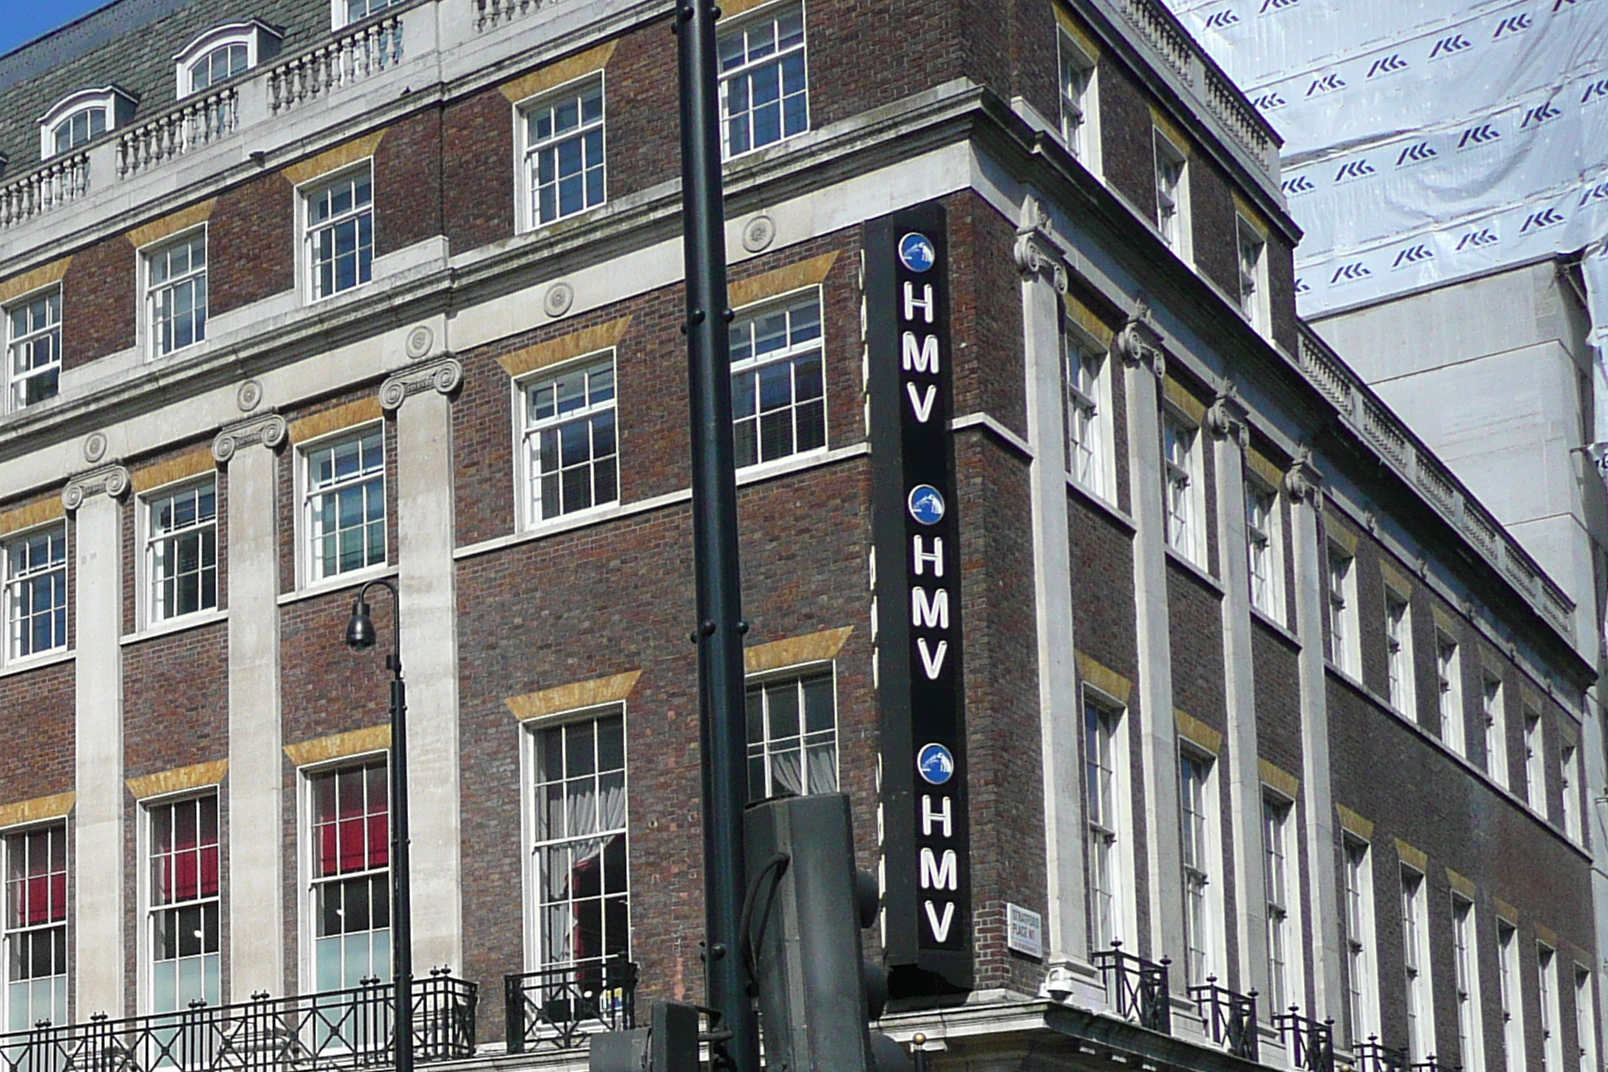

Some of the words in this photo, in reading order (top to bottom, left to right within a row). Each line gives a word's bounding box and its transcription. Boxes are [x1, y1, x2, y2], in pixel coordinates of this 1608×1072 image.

[902, 281, 939, 423] HMV
[912, 534, 949, 680] HMV
[920, 794, 957, 943] HMV
